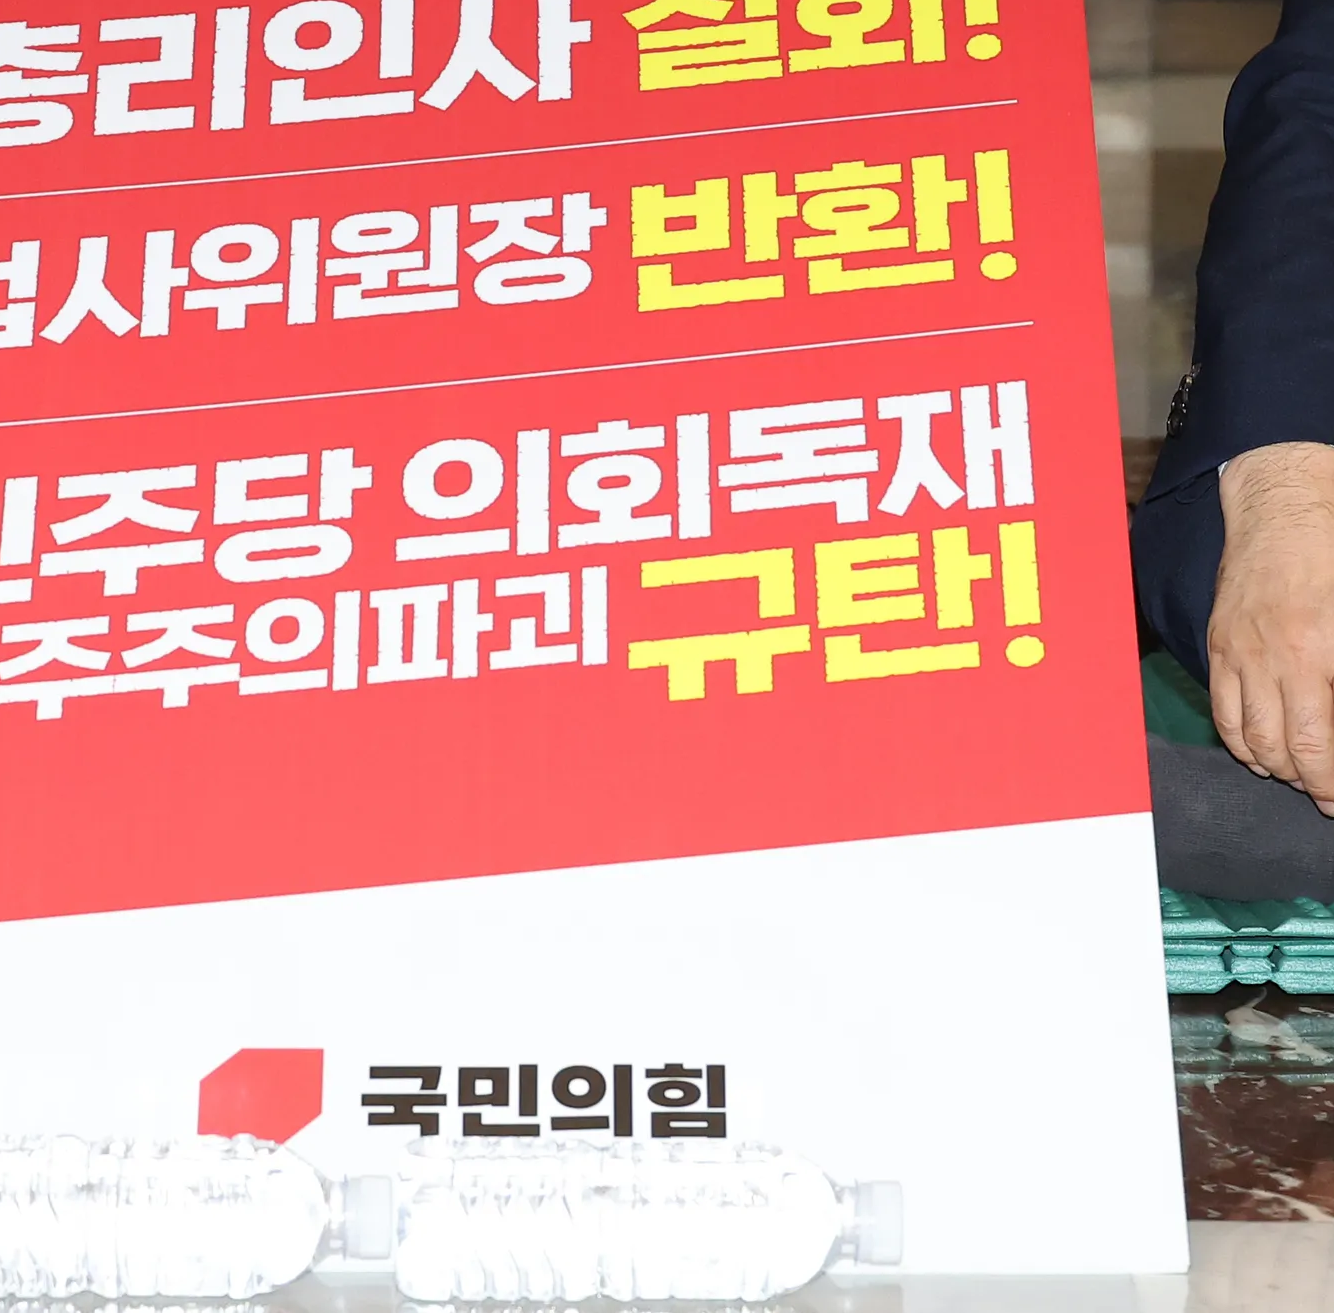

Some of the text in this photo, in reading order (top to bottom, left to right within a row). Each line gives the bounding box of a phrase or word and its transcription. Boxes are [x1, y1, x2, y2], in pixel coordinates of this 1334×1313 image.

[630, 149, 1017, 312] 반환!
[395, 381, 1035, 561] 의회독재
[628, 521, 1045, 701] 규탄!
[361, 1063, 727, 1138] 국민의힘
